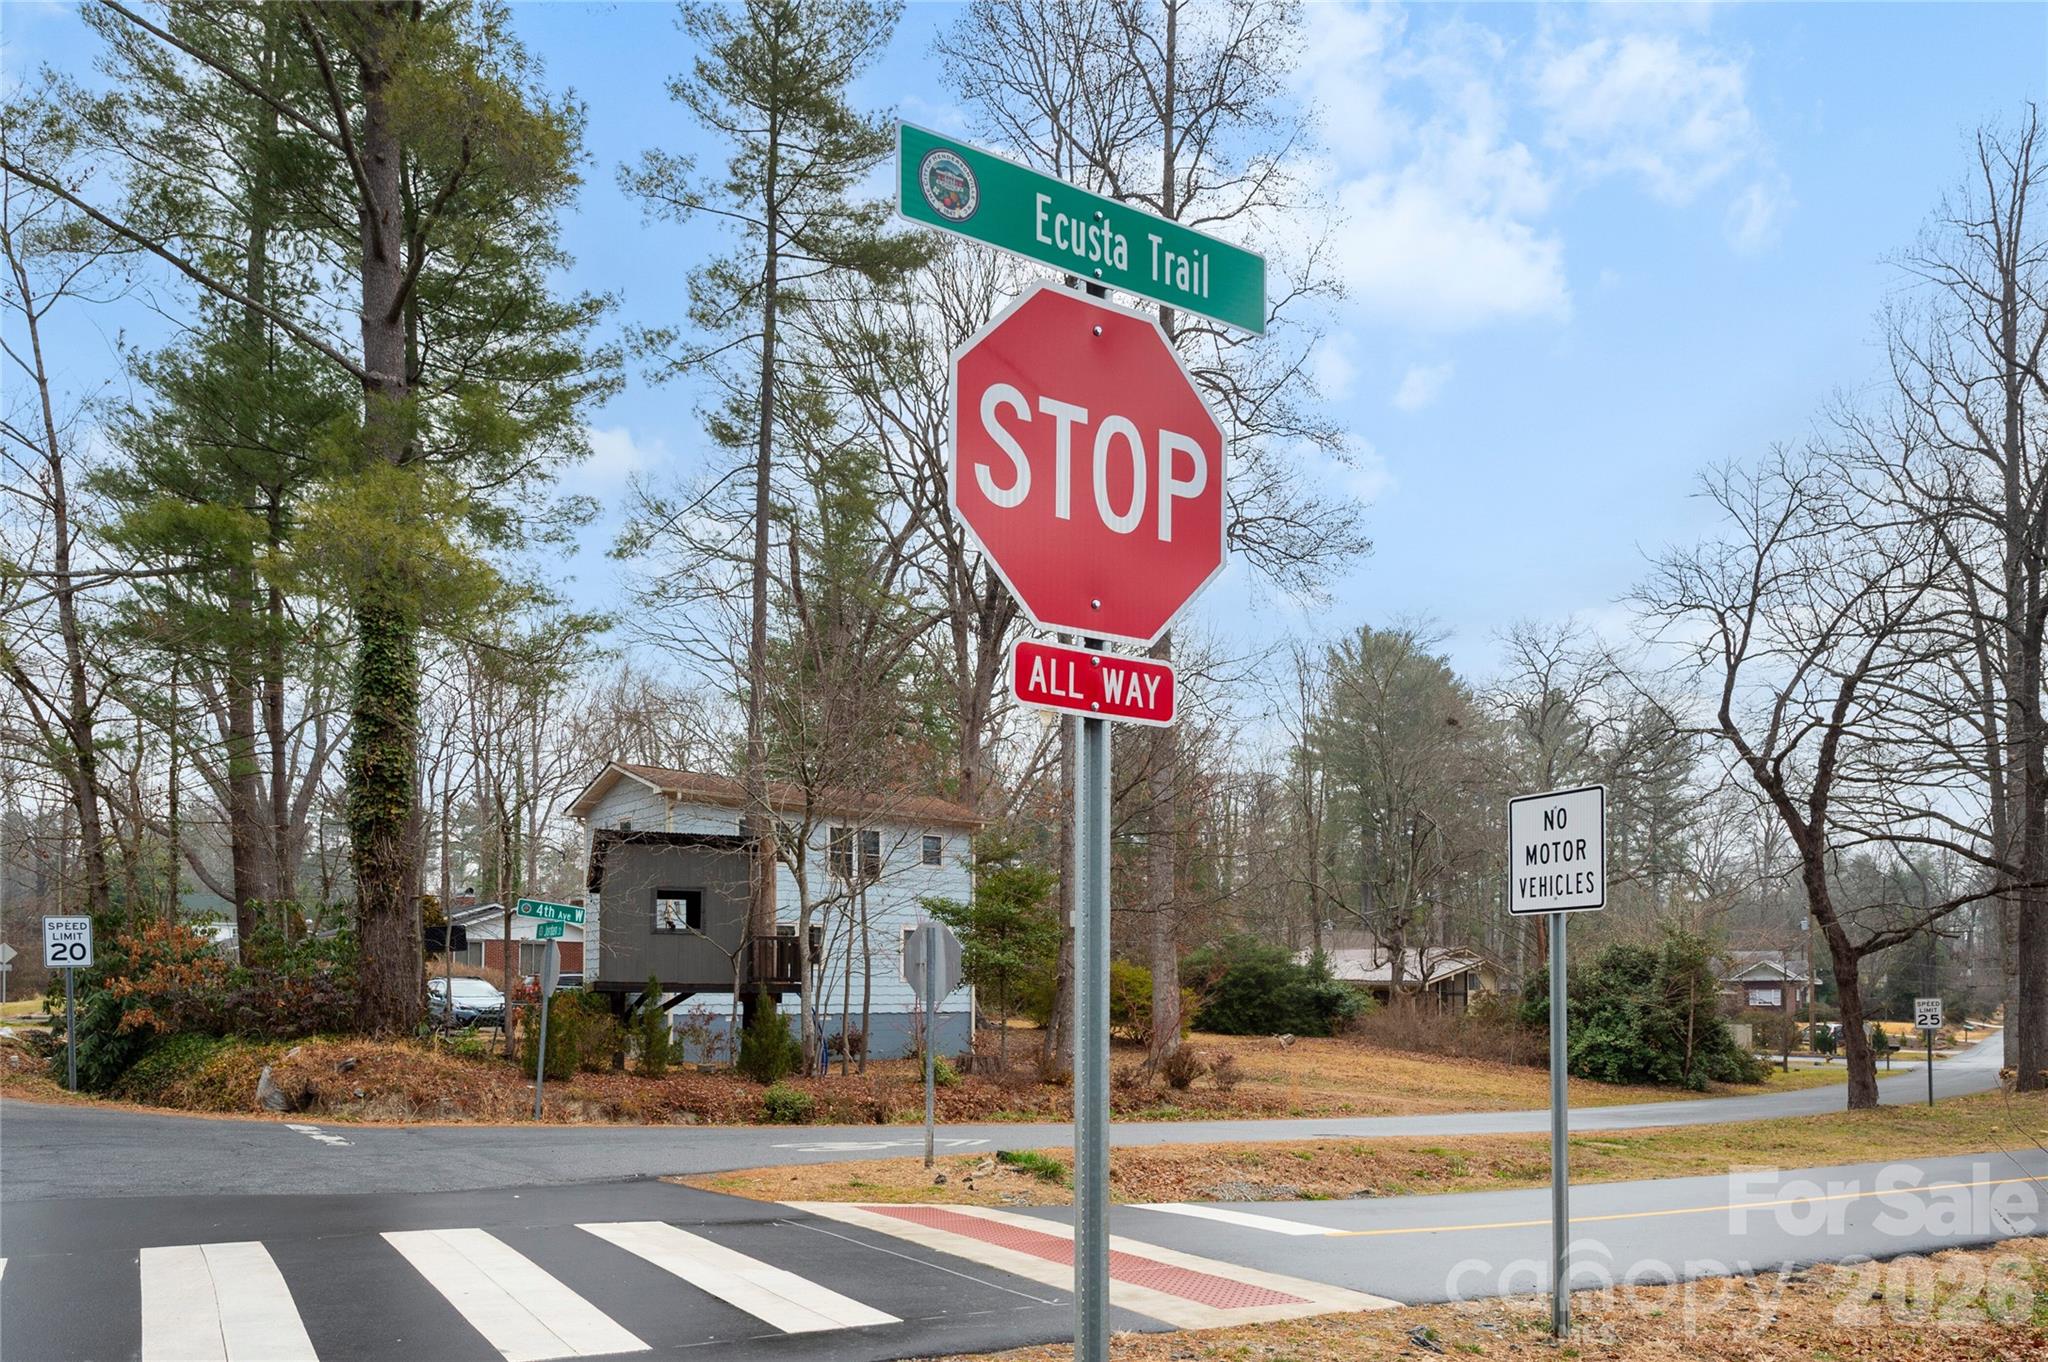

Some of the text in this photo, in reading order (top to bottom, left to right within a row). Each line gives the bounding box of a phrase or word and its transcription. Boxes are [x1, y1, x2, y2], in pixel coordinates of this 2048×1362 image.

[1036, 192, 1209, 298] Ecusta Trail
[974, 383, 1207, 542] STOP
[1028, 655, 1161, 709] ALL WAY
[1544, 808, 1567, 831] NO
[1526, 839, 1586, 866] MOTOR
[1519, 871, 1594, 898] VEHICLES
[536, 904, 584, 922] 4th Ave W
[48, 922, 87, 930] SPEED
[52, 932, 82, 940] LIMIT
[51, 943, 86, 960] 20
[1918, 1014, 1940, 1025] 25
